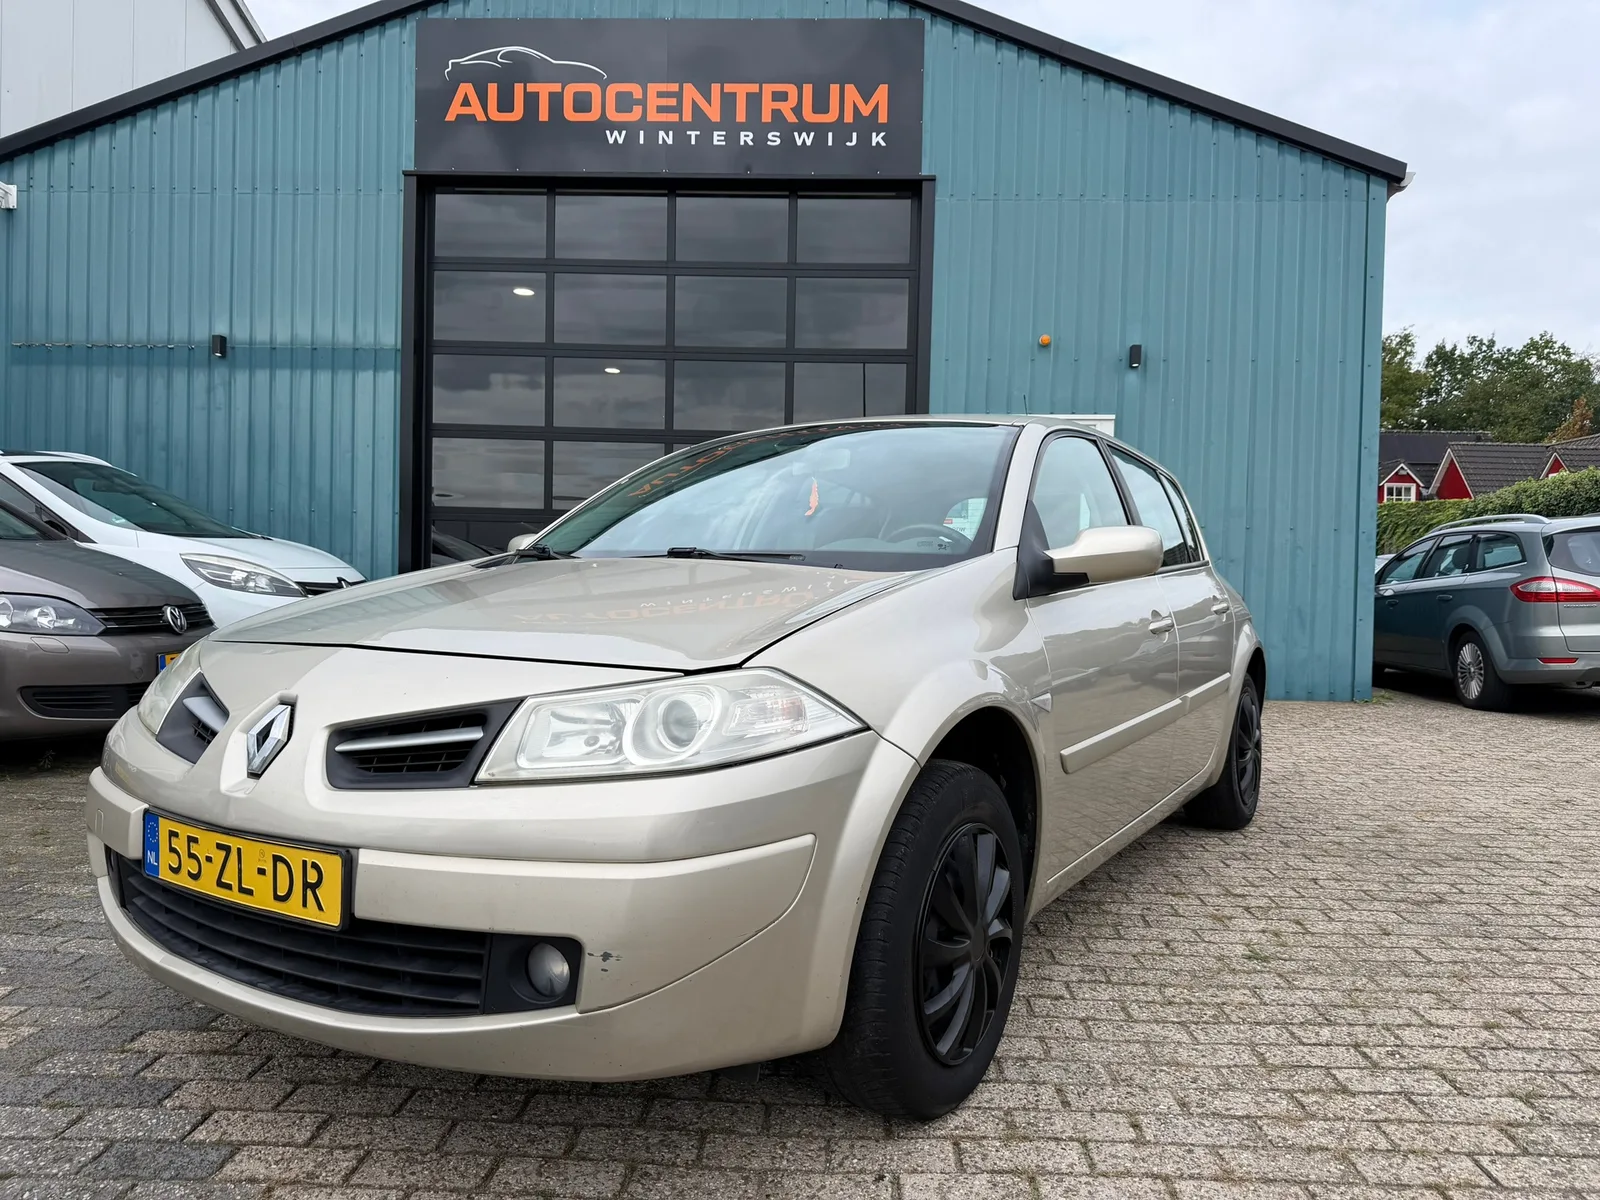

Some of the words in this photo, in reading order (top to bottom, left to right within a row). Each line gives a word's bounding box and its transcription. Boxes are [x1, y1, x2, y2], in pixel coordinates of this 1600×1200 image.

[445, 82, 889, 123] AUTOCENTRUM
[605, 129, 888, 147] WINTERSWIJK
[147, 849, 158, 866] NL
[167, 828, 325, 912] 55-ZL-DR
